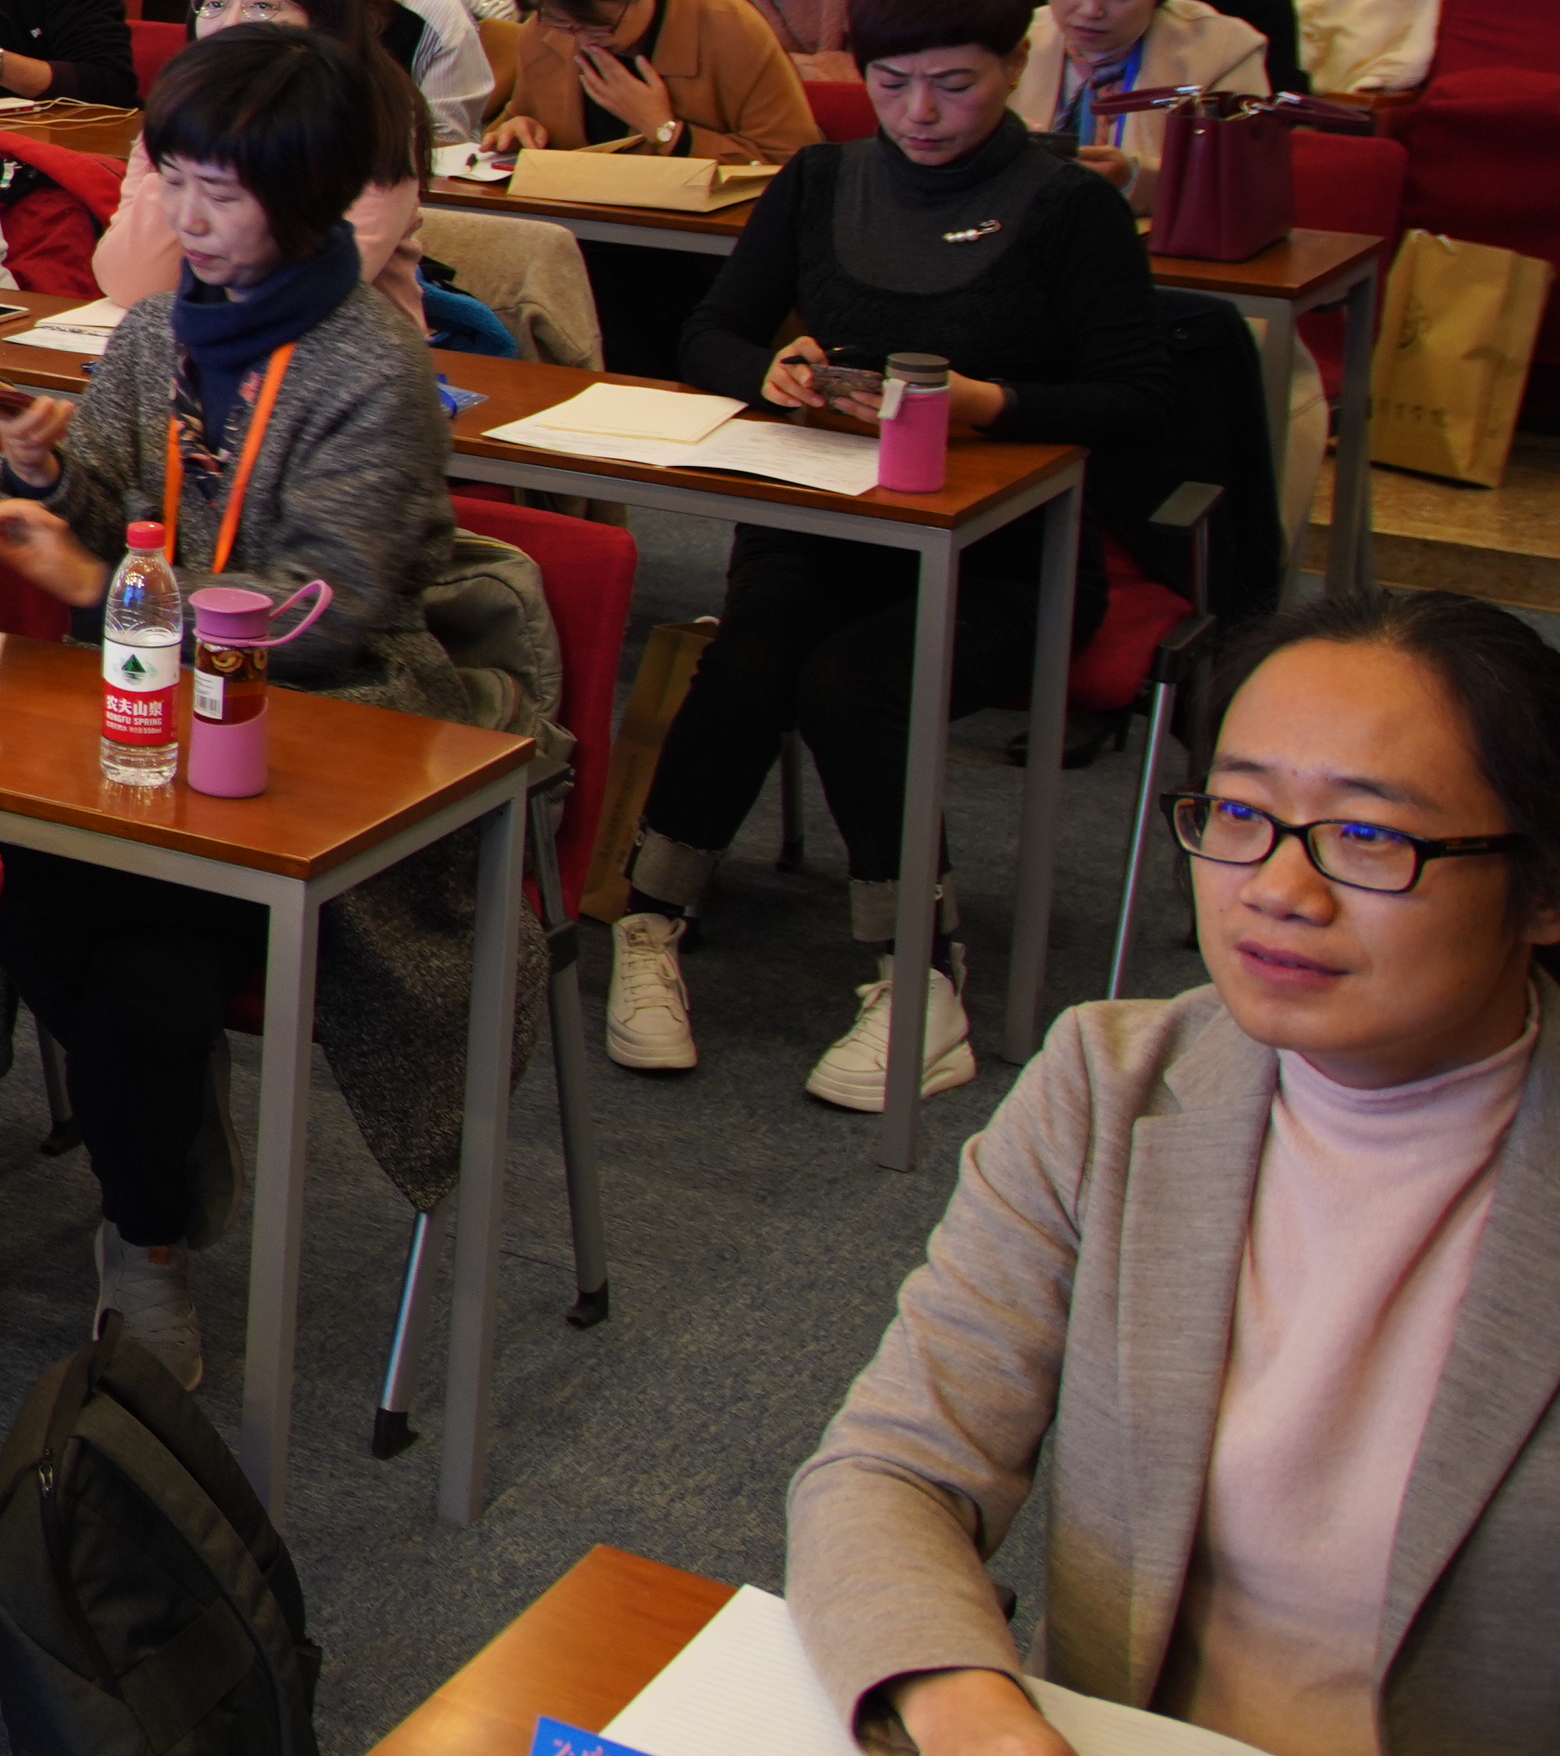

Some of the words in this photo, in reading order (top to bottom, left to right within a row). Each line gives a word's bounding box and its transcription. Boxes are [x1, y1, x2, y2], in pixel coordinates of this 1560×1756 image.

[105, 694, 163, 717] 农夫山泉
[133, 717, 163, 726] SPRING
